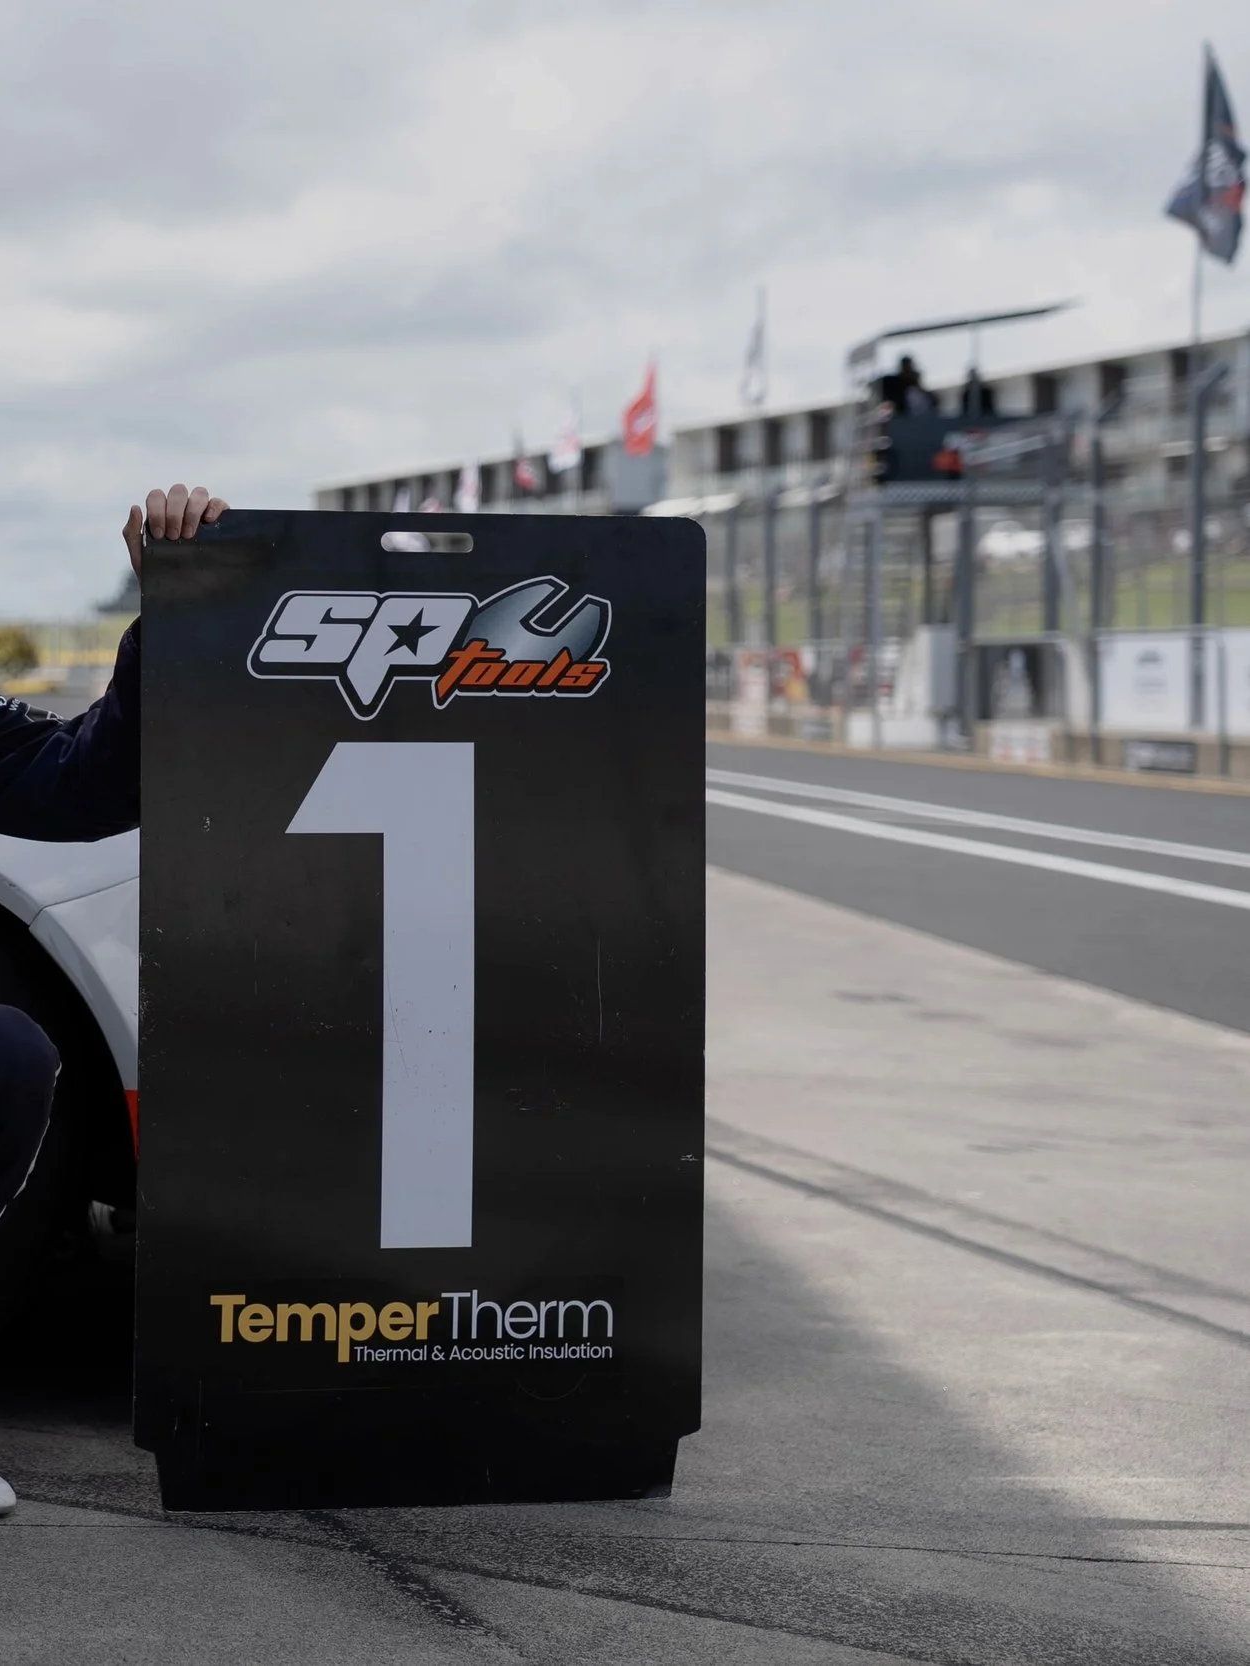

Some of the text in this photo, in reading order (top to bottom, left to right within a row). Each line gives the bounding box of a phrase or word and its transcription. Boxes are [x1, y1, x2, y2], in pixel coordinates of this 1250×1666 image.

[285, 742, 474, 1248] 1
[354, 1342, 613, 1362] Thermal & Acoustic Insulation
